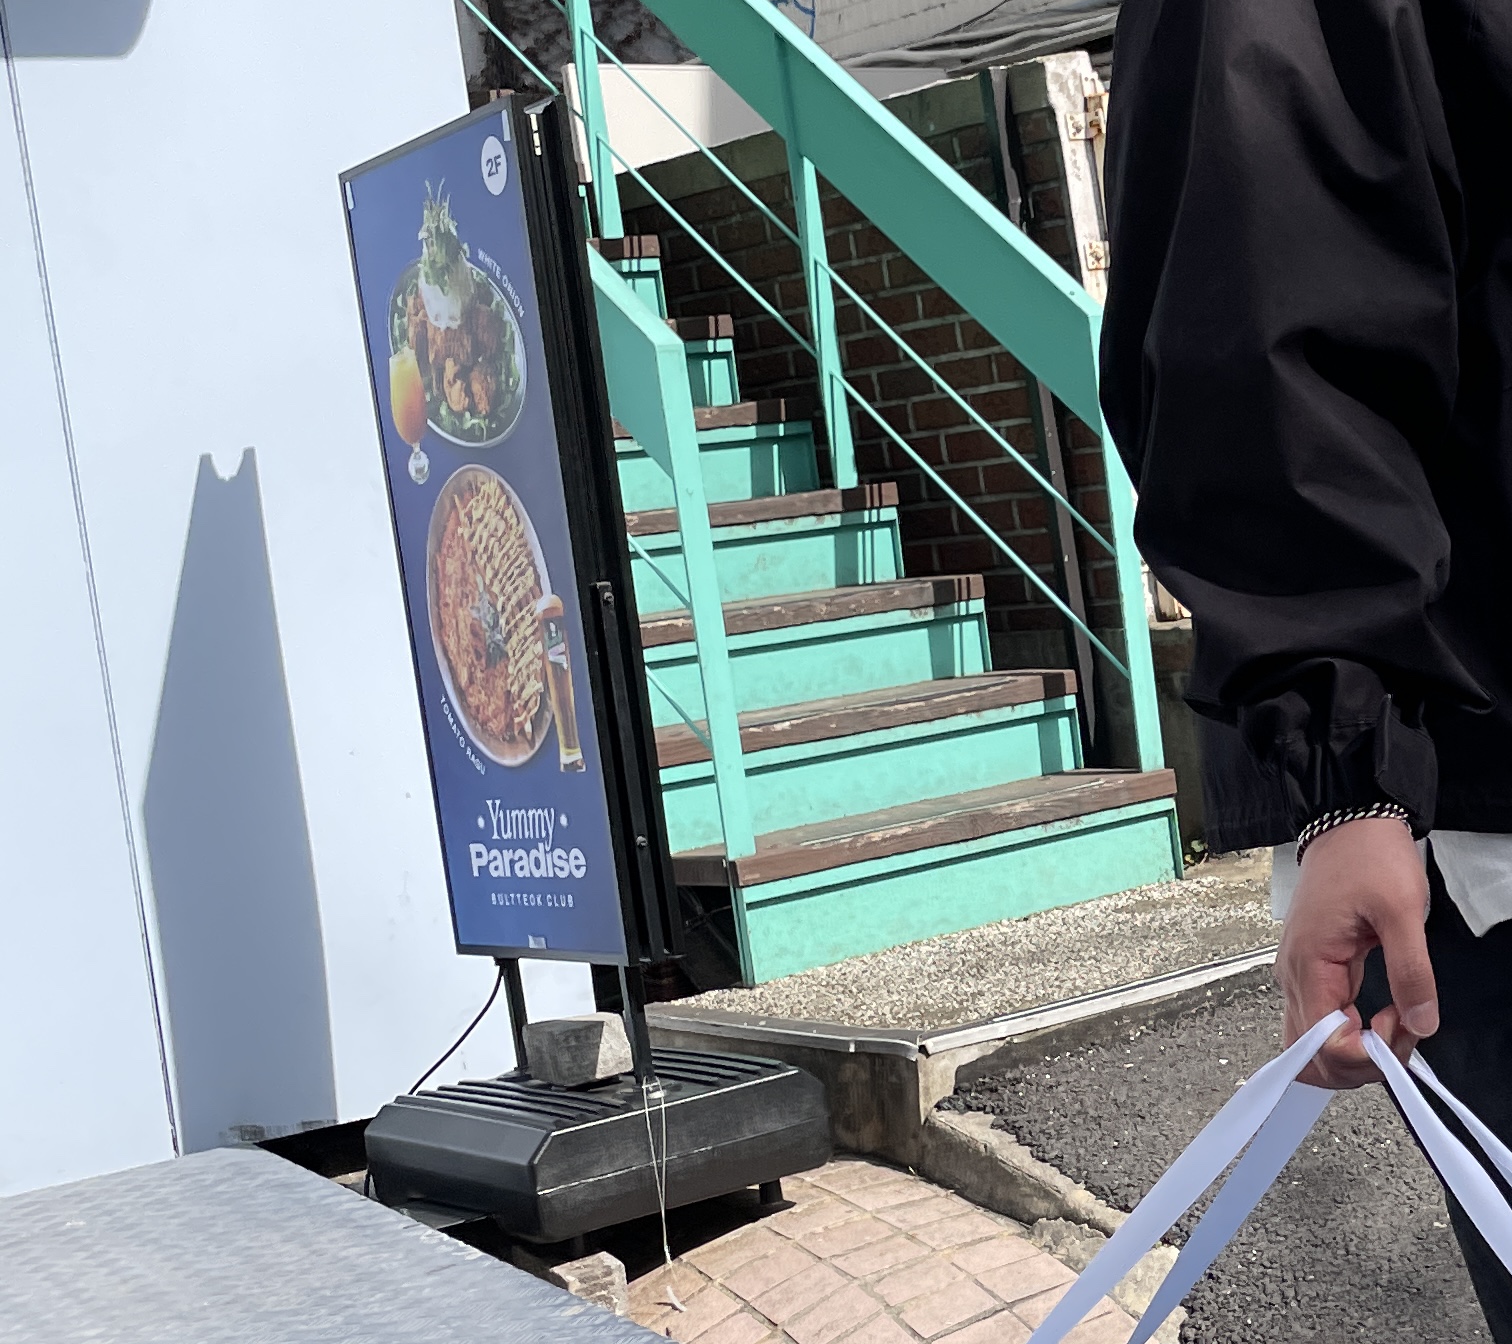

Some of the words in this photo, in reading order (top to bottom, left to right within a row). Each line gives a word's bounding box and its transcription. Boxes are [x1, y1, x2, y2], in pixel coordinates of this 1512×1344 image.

[486, 155, 502, 178] 2F
[477, 248, 502, 281] WHITE
[440, 693, 466, 748] TOMATO
[485, 798, 555, 852] Yummy
[468, 842, 588, 879] Paradise
[546, 894, 575, 908] CLUB
